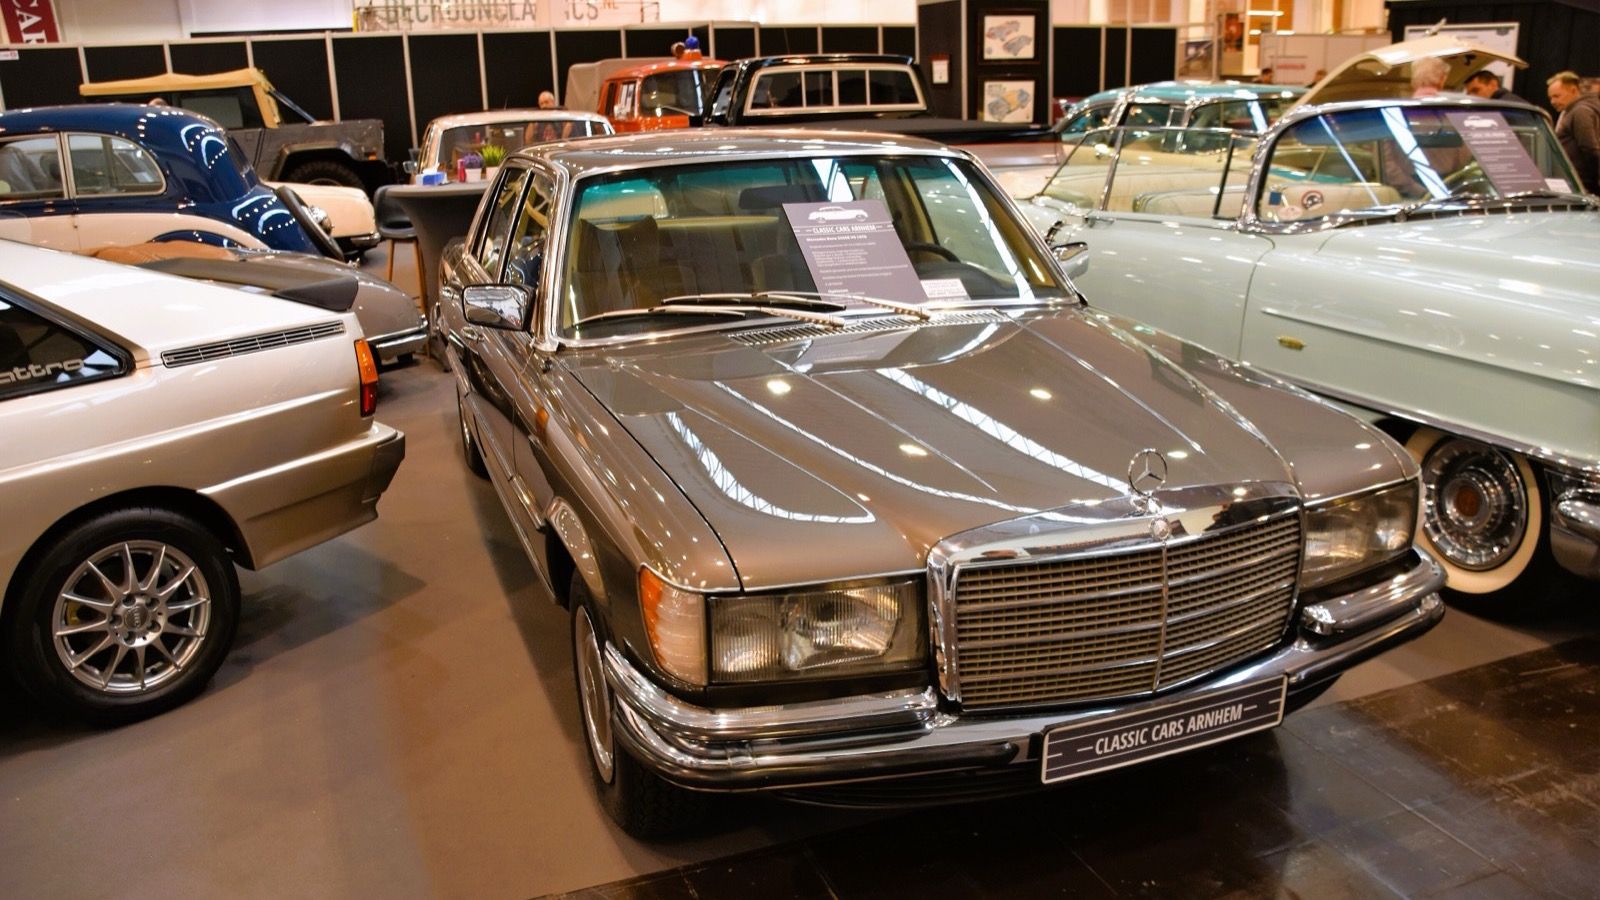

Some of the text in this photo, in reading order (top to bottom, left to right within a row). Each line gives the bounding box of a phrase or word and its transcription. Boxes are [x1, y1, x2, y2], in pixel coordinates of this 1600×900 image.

[1095, 703, 1243, 755] CLASSIC CARS ARNHEM
